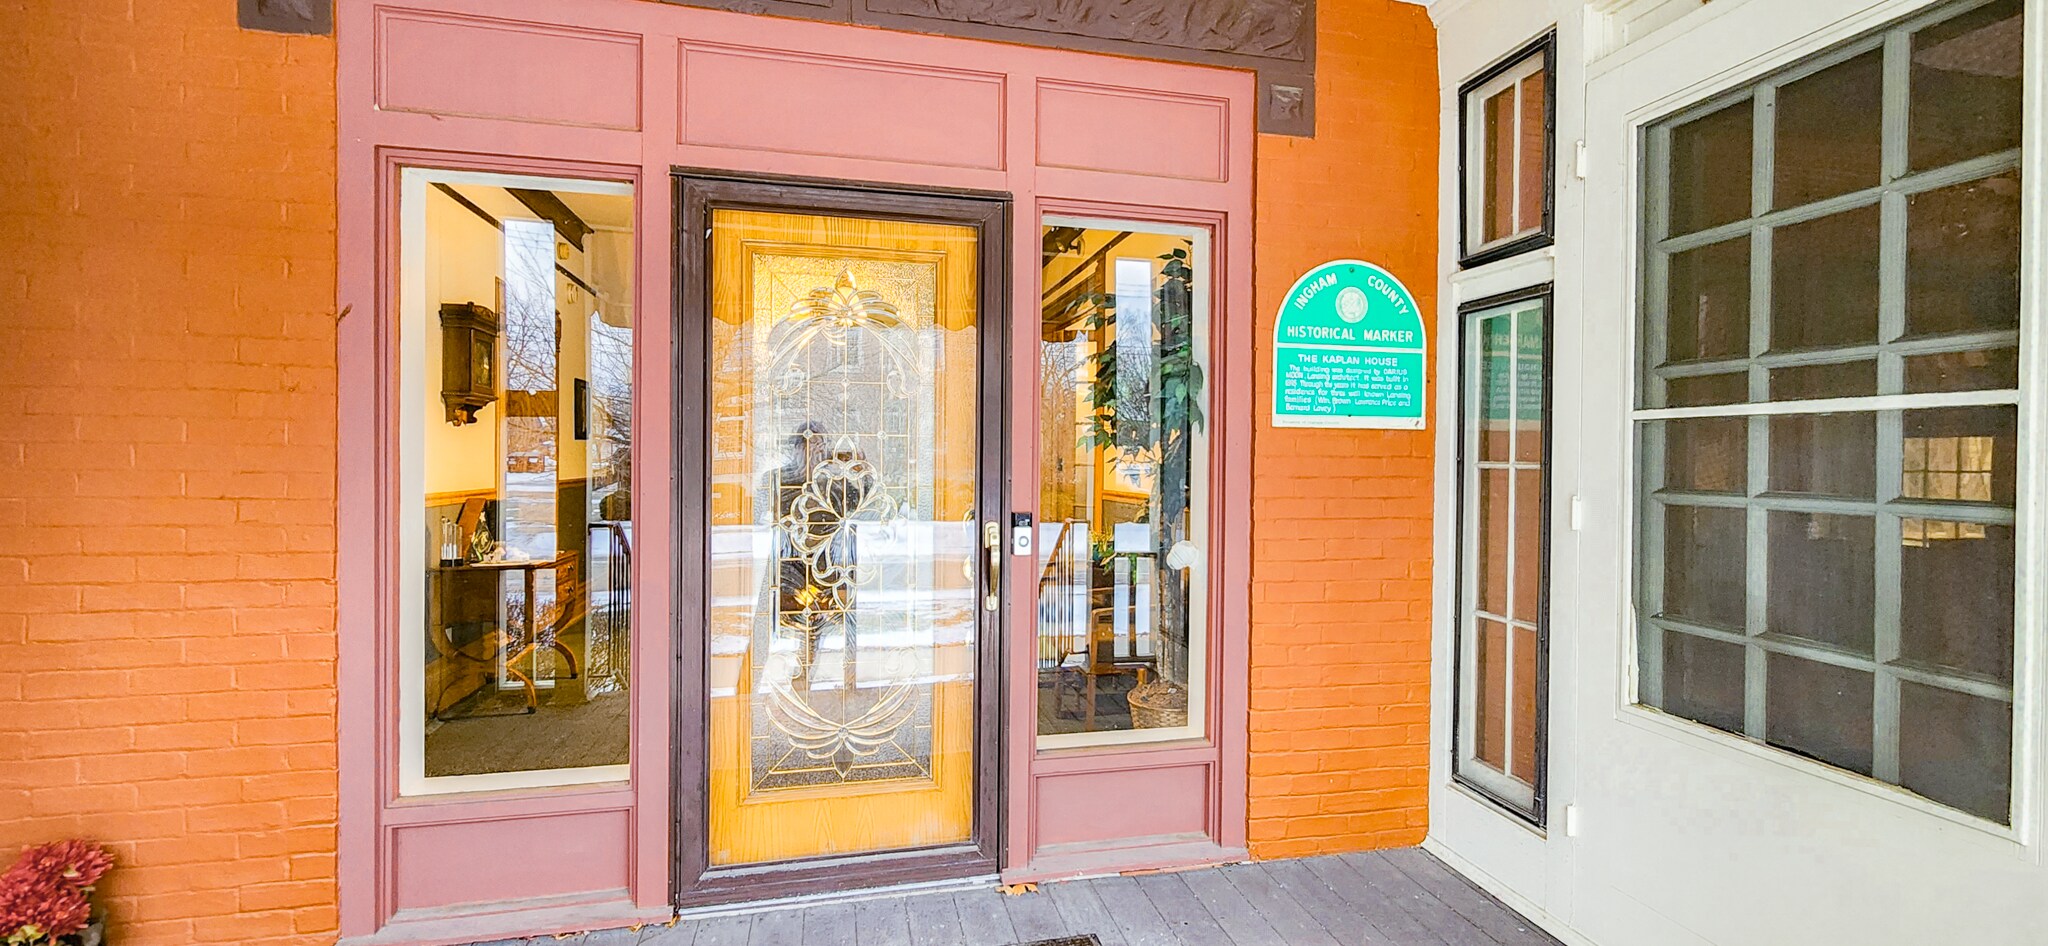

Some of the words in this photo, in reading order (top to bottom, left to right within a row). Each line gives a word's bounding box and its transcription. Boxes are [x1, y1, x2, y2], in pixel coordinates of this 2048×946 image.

[1294, 272, 1338, 310] INGHAM
[1367, 275, 1410, 315] COUNTY
[1287, 325, 1356, 340] HISTORICAL
[1363, 329, 1414, 342] MARKER
[1298, 354, 1318, 363] THE
[1322, 355, 1360, 365] KAPLAN
[1364, 357, 1398, 366] HOUSE
